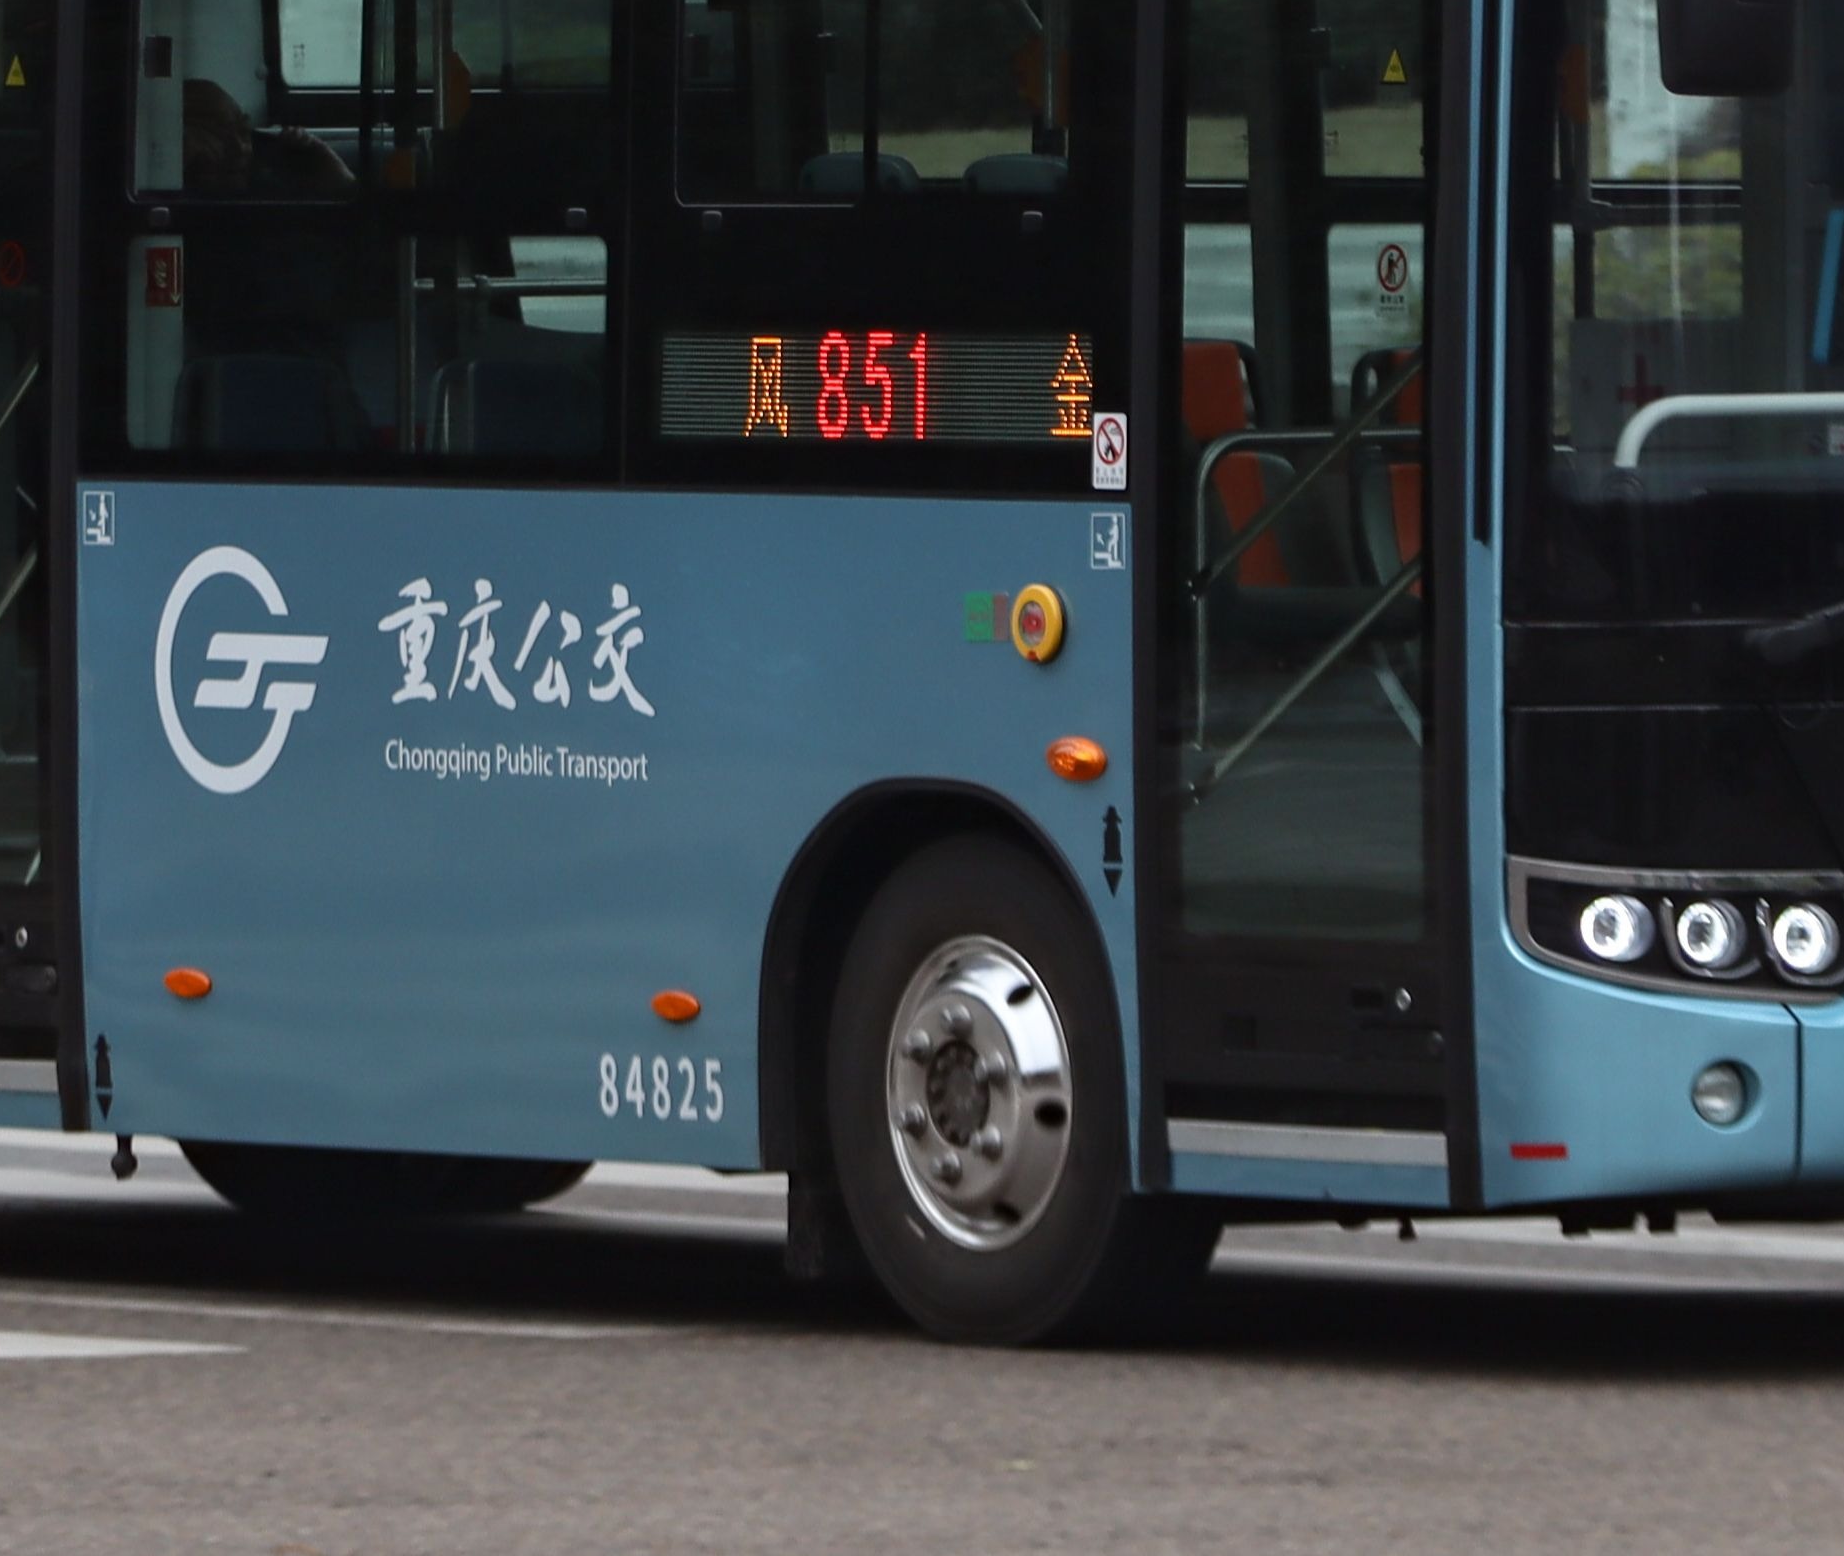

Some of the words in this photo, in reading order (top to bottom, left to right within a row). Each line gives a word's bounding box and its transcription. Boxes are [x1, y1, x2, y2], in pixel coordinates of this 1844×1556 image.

[743, 336, 788, 438] 风
[817, 331, 927, 439] 851
[1049, 333, 1093, 436] 金
[378, 577, 655, 717] 重庆公交
[385, 739, 491, 781] Chongqing
[496, 744, 553, 776] Public
[556, 746, 649, 787] Transport
[599, 1052, 724, 1123] 84825
